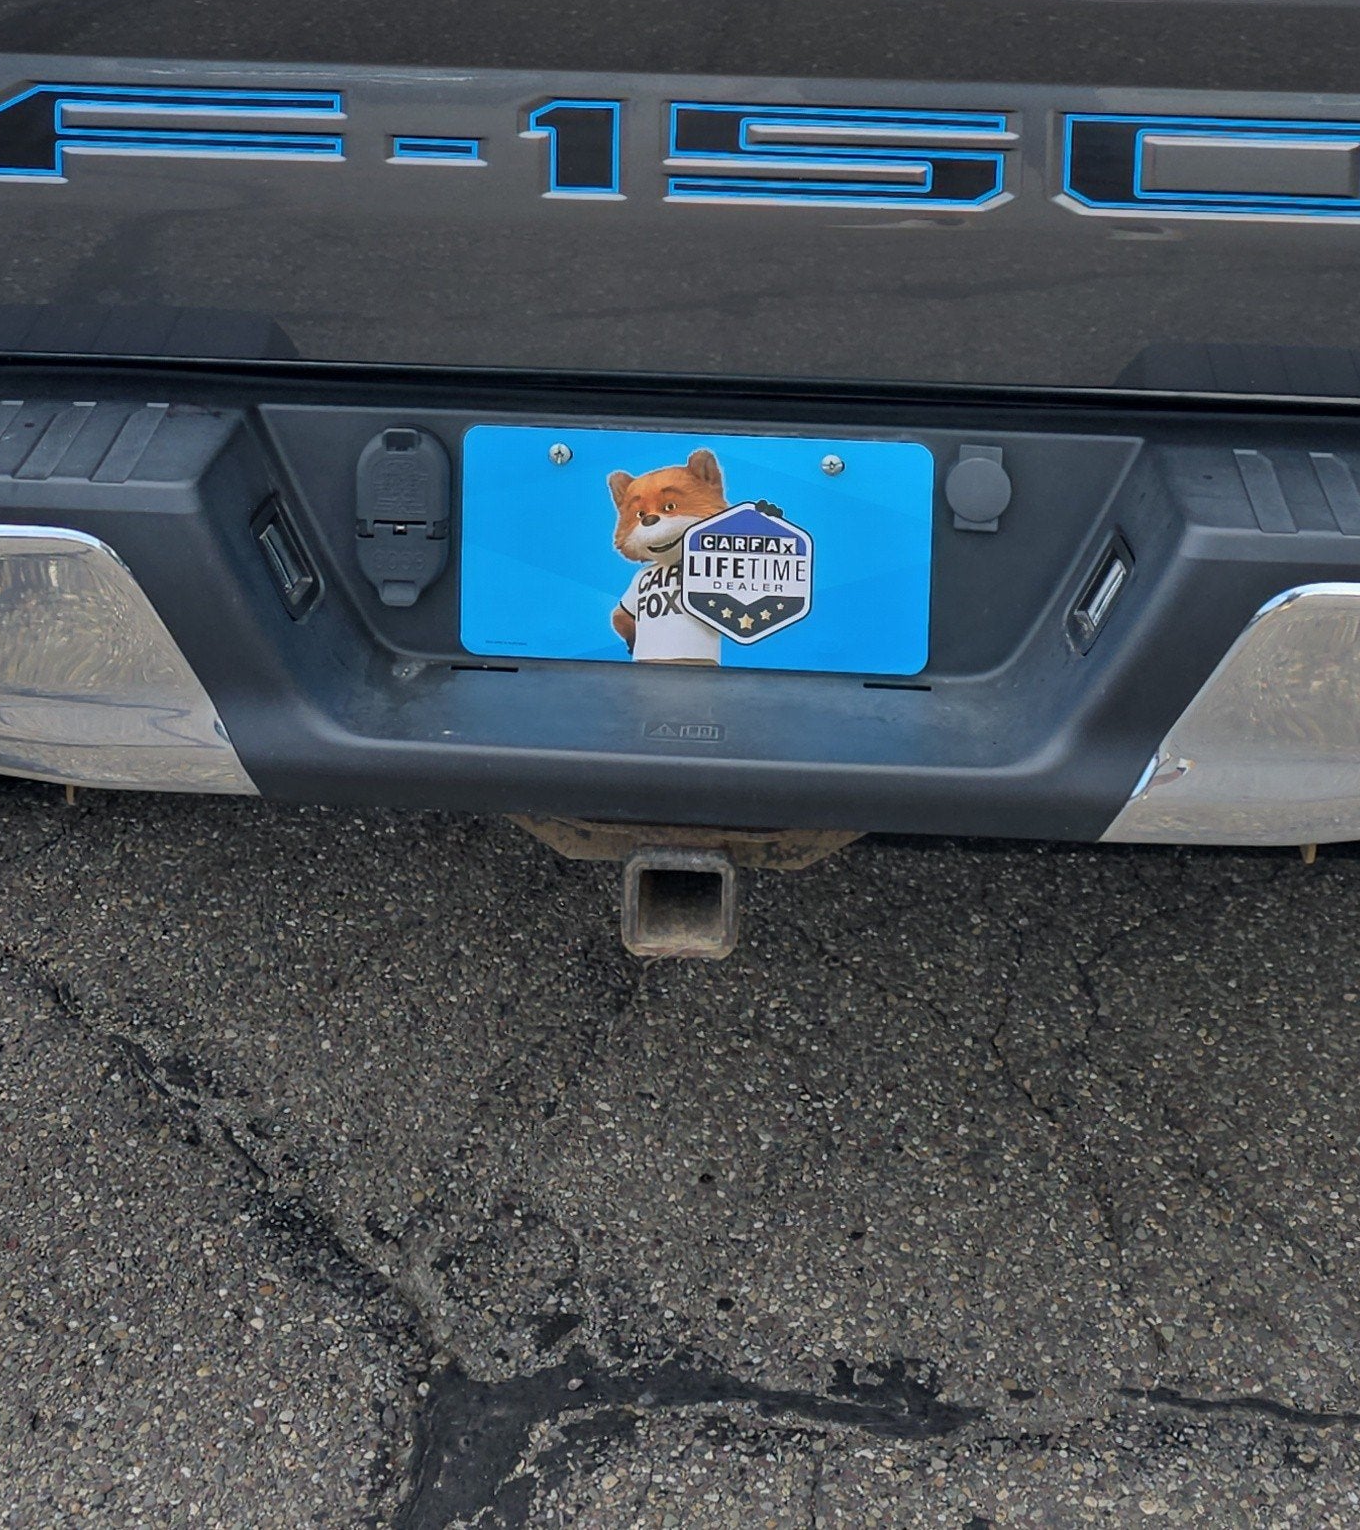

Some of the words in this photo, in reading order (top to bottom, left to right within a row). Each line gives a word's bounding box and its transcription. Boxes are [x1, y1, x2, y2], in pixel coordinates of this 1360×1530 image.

[702, 535, 796, 554] CARFAX
[638, 564, 683, 595] CAR
[689, 556, 806, 582] LIFETIME
[713, 581, 784, 593] DEALER
[637, 589, 684, 621] FOX
